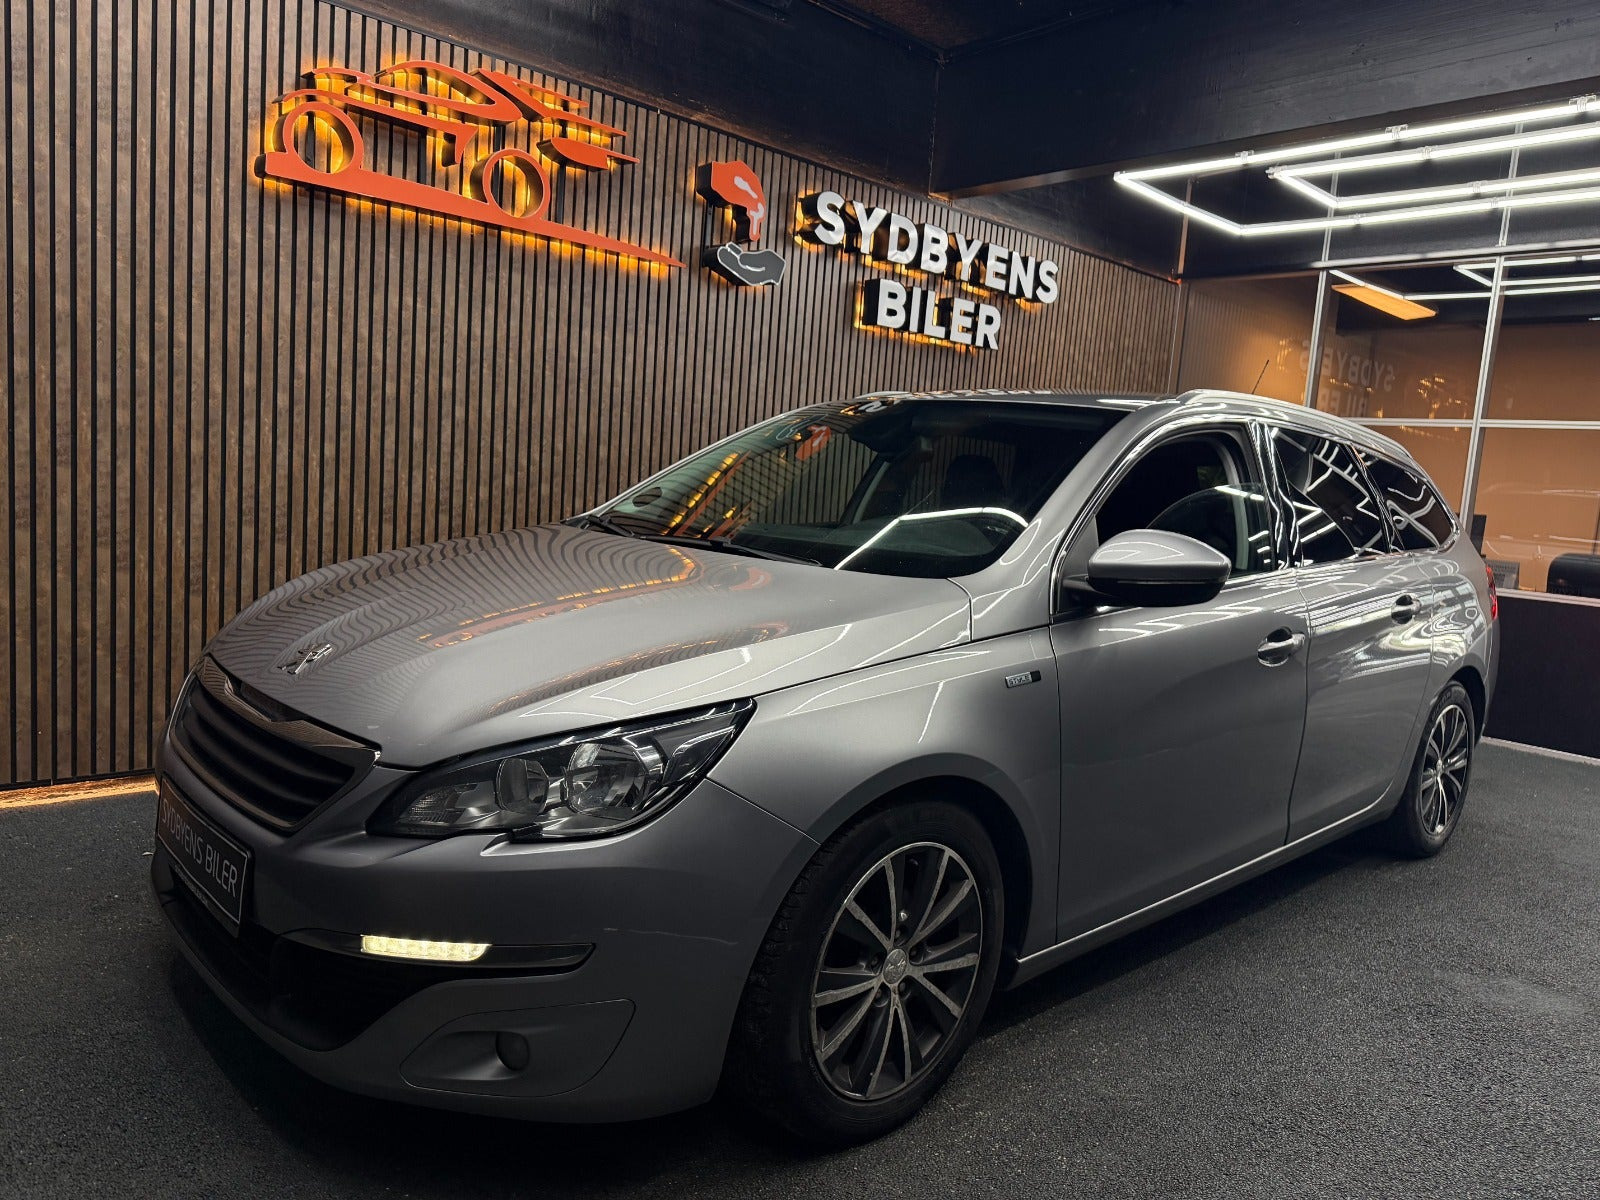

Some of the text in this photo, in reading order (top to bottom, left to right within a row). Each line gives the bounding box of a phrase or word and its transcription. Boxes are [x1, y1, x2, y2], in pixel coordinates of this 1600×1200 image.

[814, 190, 1060, 304] SYDBYENS
[876, 278, 1001, 350] BILER
[162, 798, 204, 865] SYDBYENS
[205, 843, 238, 898] BILER
